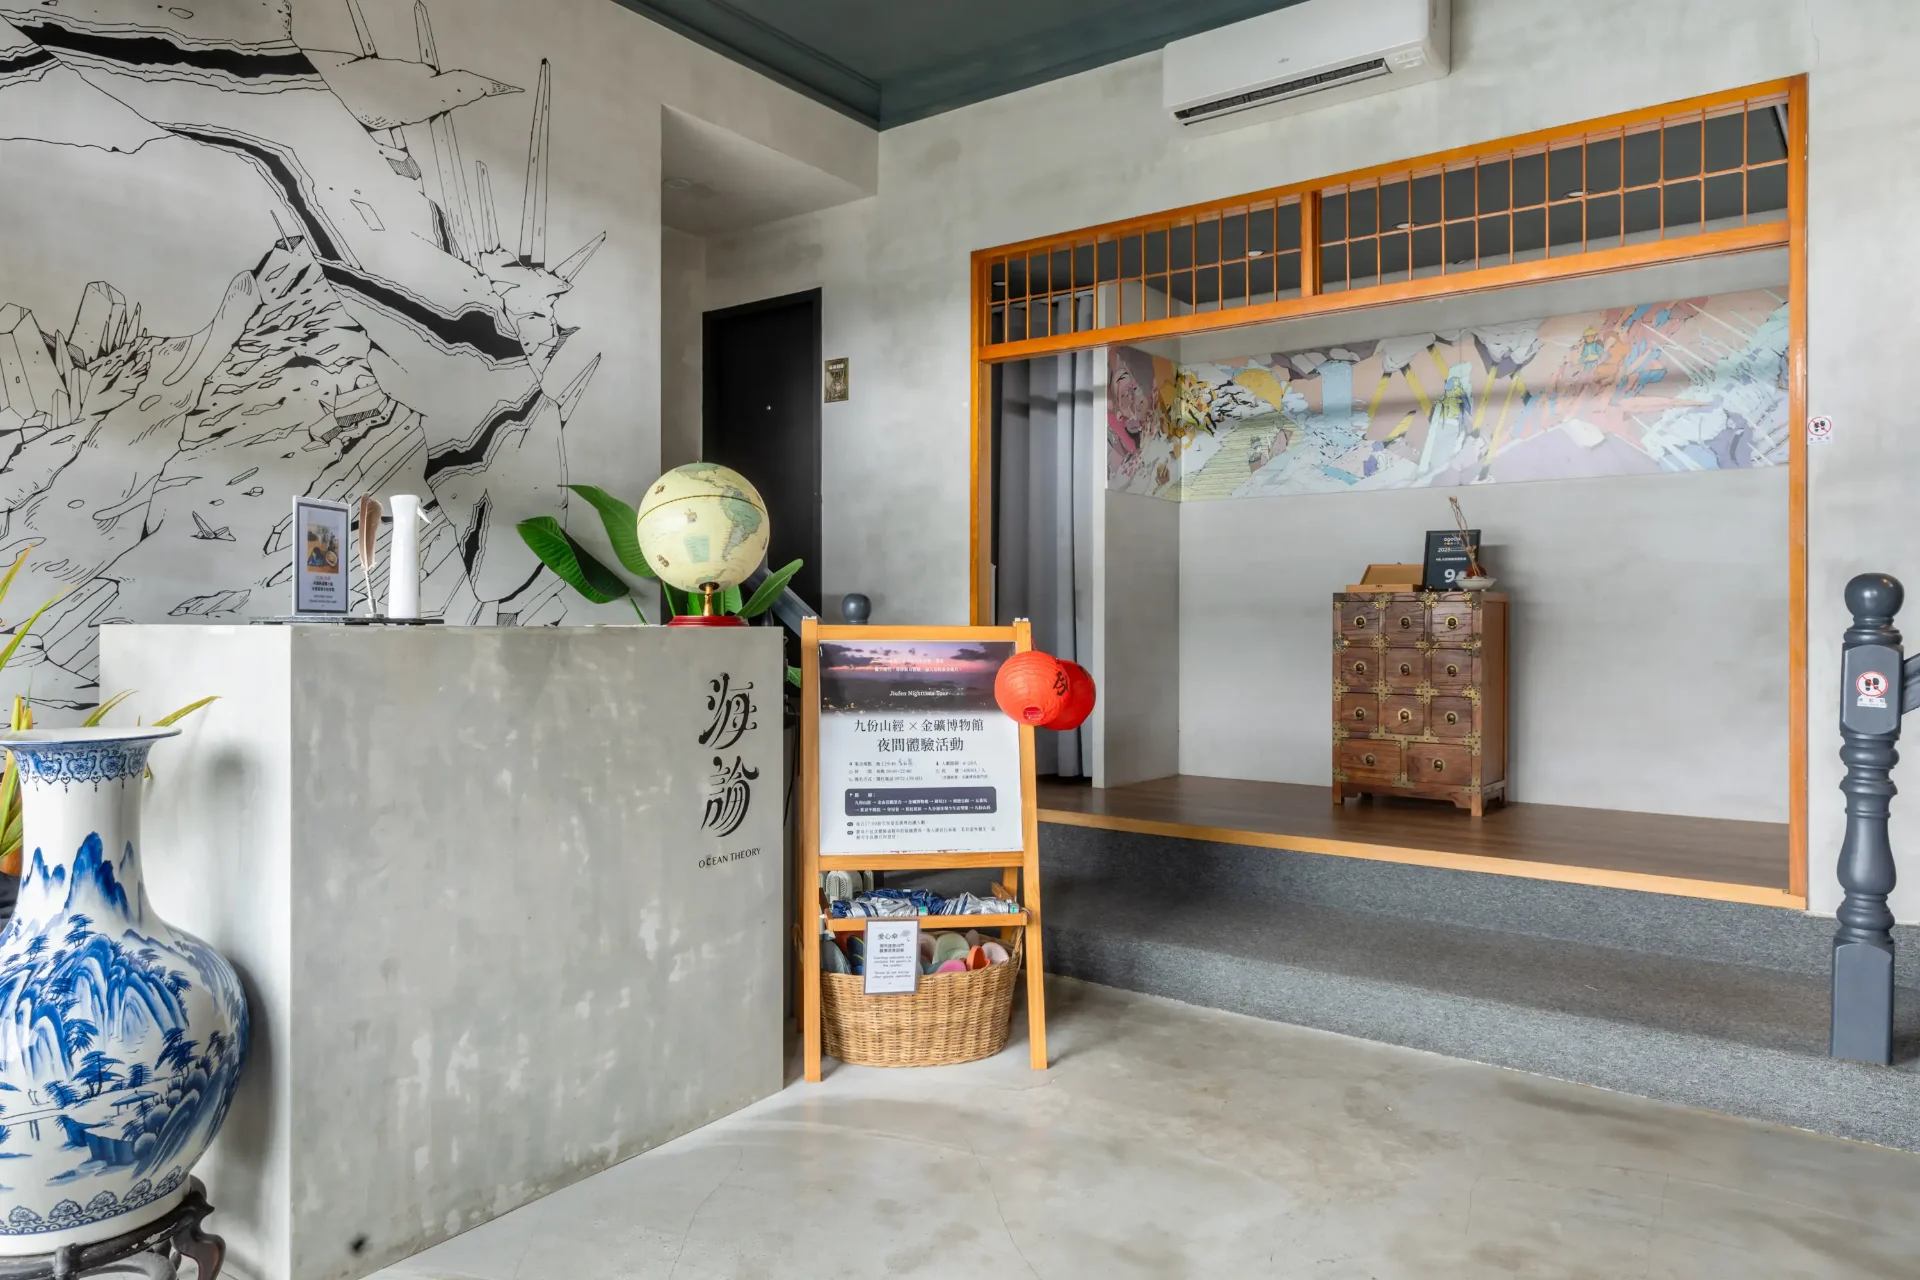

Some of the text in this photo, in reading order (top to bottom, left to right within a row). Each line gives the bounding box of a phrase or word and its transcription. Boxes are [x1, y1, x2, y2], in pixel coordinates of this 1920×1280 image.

[854, 718, 904, 732] 九份山經
[920, 718, 984, 732] 金礦博物館
[877, 737, 964, 752] 夜間體驗活動
[698, 847, 761, 869] OCEAN THEORY
